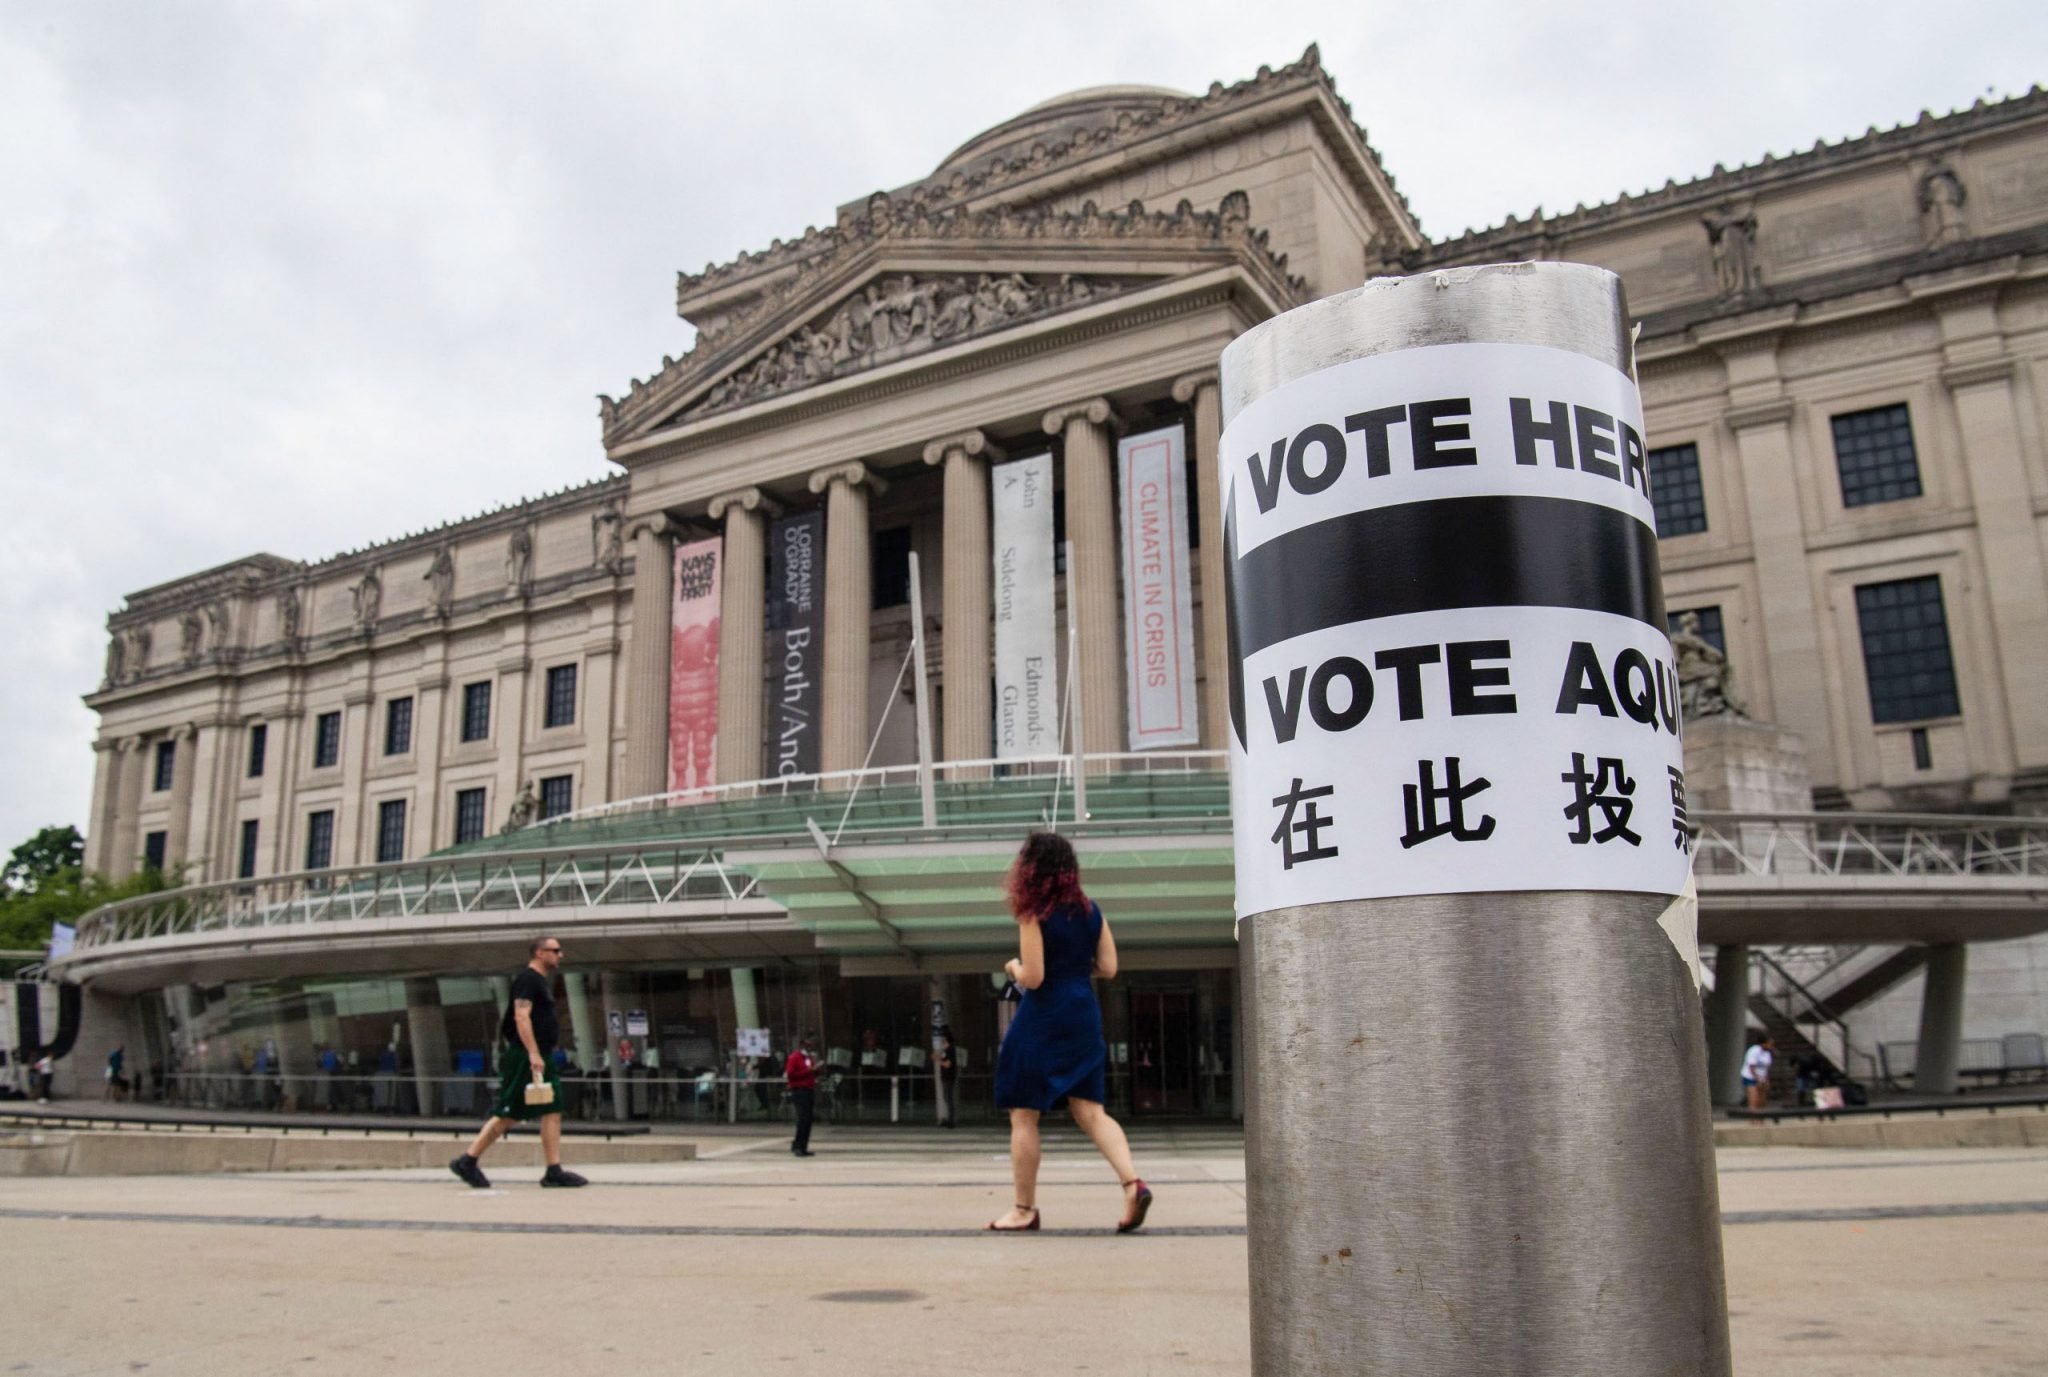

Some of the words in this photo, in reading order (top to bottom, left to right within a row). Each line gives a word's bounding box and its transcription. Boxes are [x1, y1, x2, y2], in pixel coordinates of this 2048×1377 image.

[1004, 475, 1018, 489] A
[1023, 468, 1040, 509] John
[1247, 397, 1478, 515] VOTE
[1509, 397, 1652, 501] HER
[784, 526, 800, 604] O'GRADY
[1140, 481, 1162, 577] CLIMATE
[797, 523, 812, 613] LORRAINE
[1000, 546, 1016, 622] Sidelong
[1143, 582, 1163, 606] IN
[1144, 611, 1167, 688] CRISIS
[1003, 684, 1019, 748] Glance
[1025, 655, 1045, 747] Edmonds:
[1262, 640, 1517, 744] VOTE
